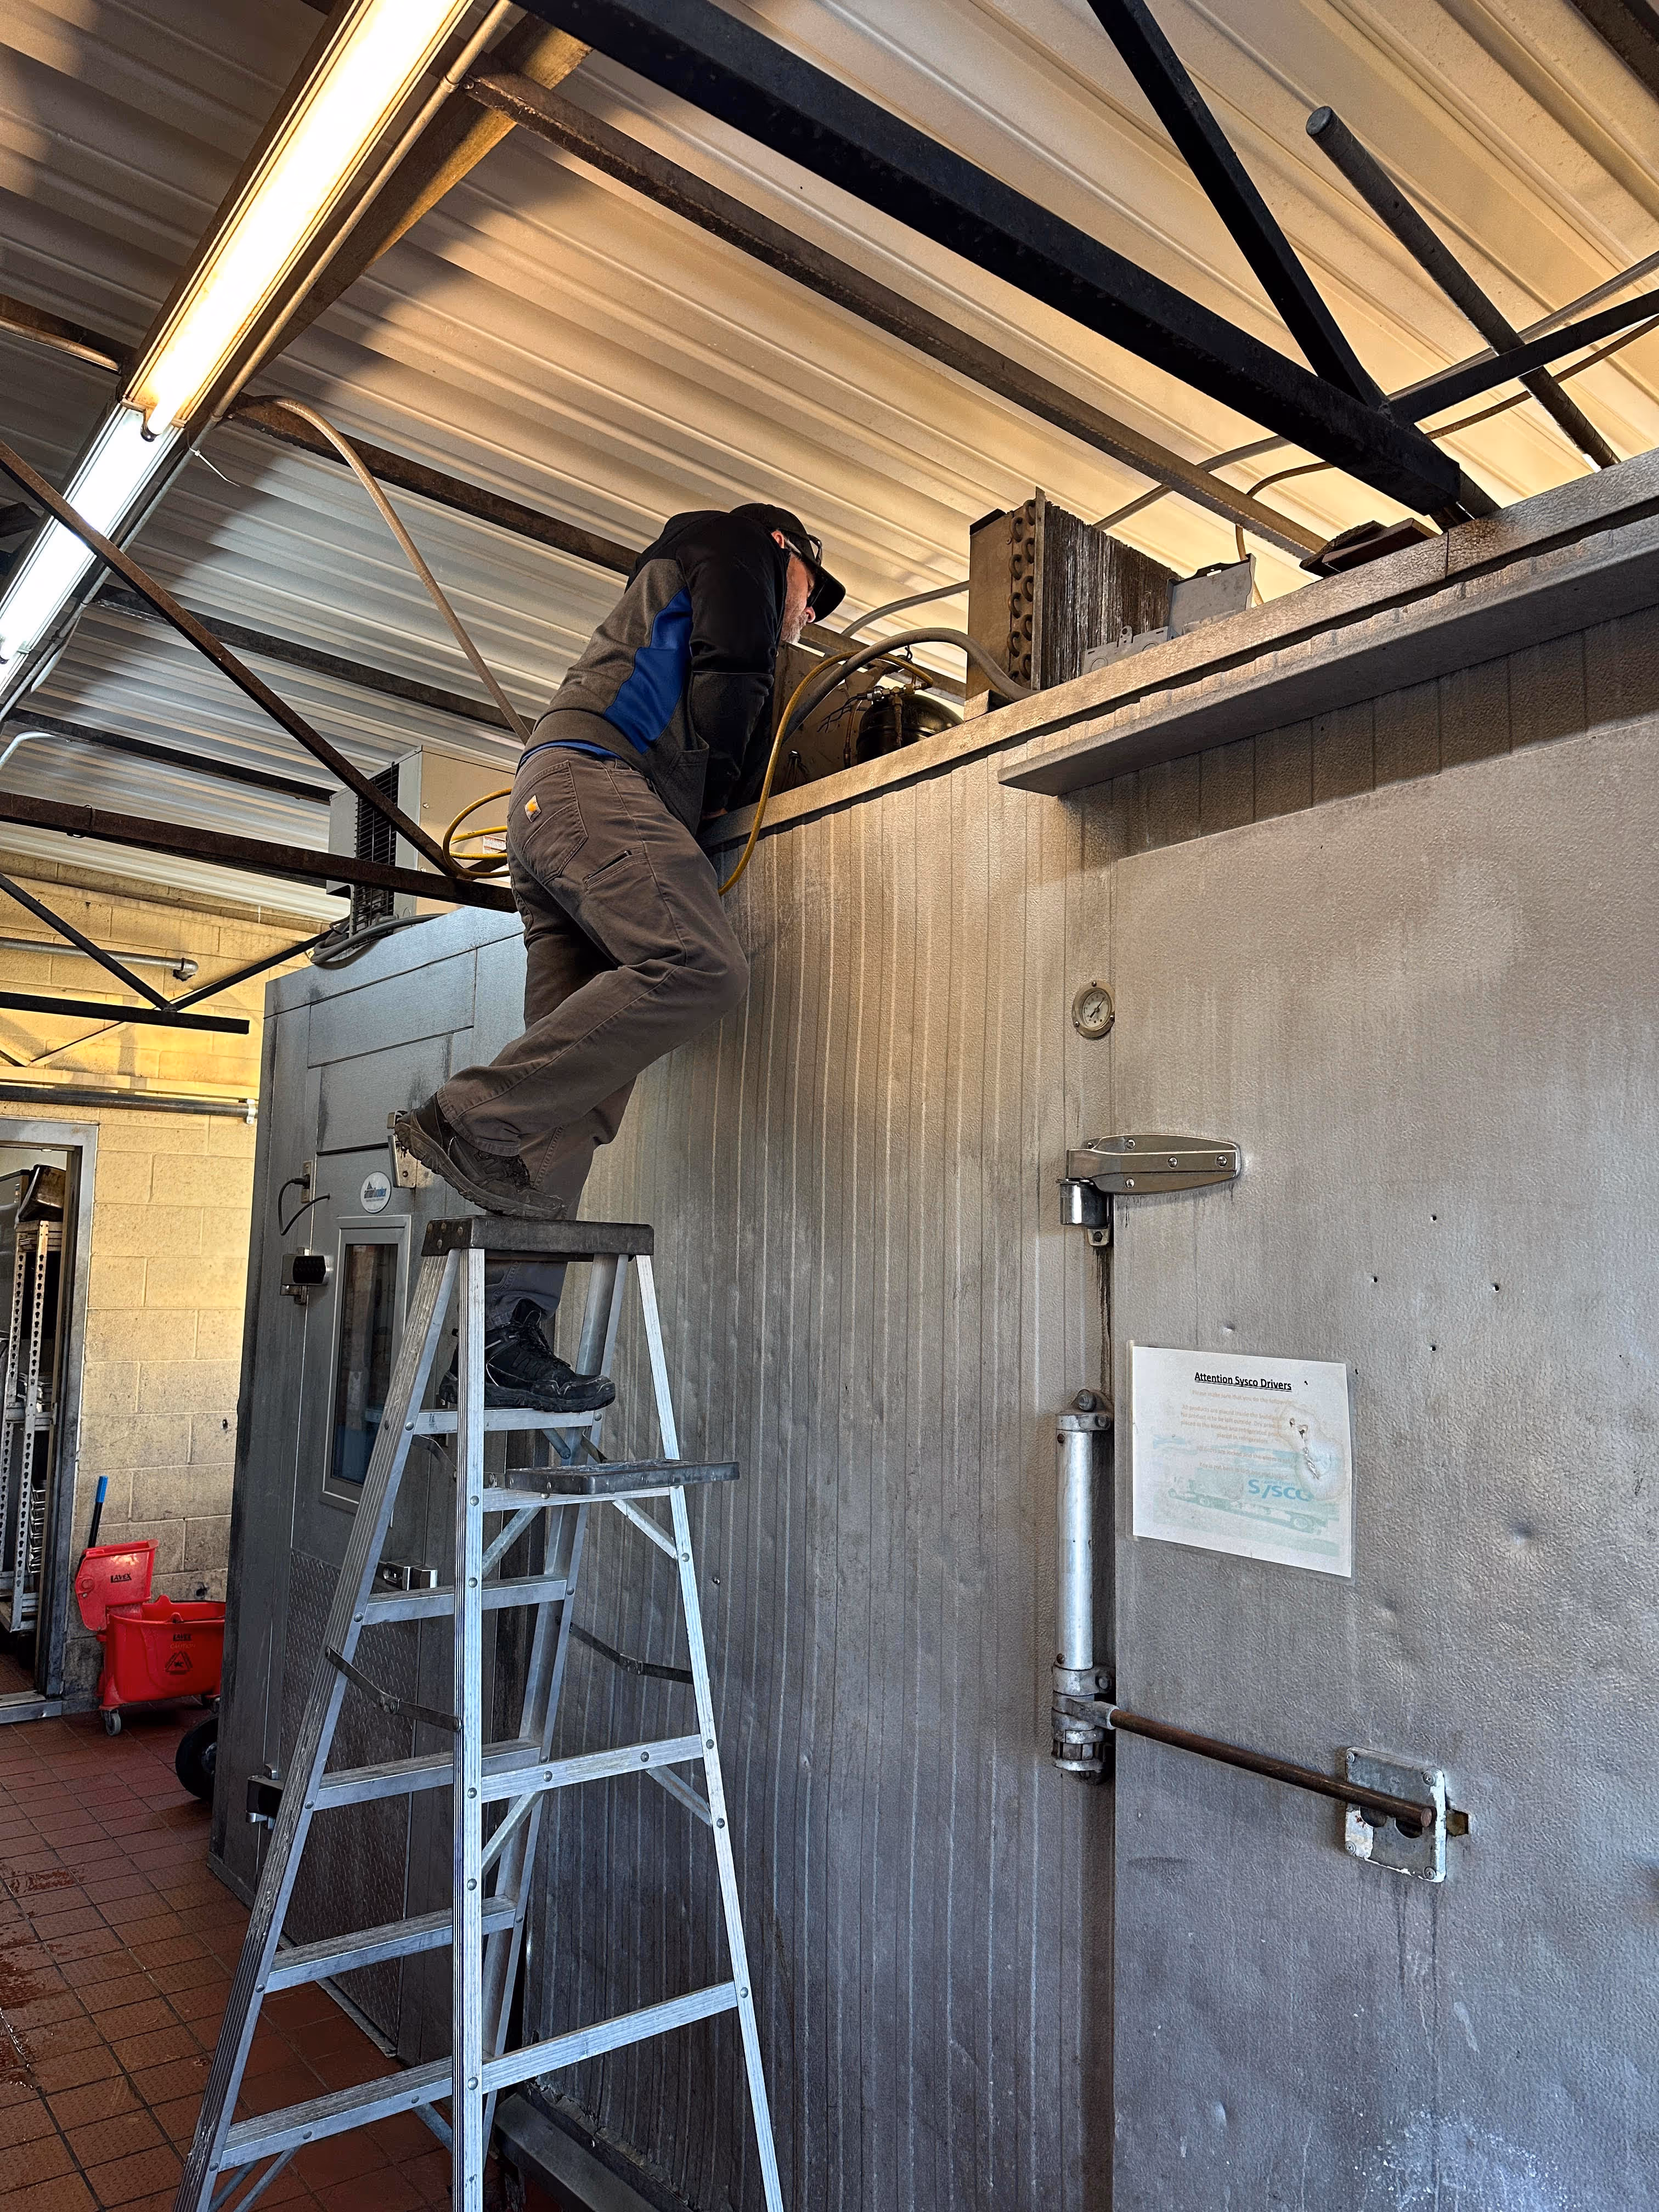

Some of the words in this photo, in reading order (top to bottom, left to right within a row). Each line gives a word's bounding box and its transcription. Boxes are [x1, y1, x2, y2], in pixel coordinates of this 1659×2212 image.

[1194, 1372, 1233, 1384] Attention
[1235, 1376, 1259, 1387] Sysco
[1261, 1379, 1292, 1391] Drivers
[110, 1573, 132, 1583] LAVEX
